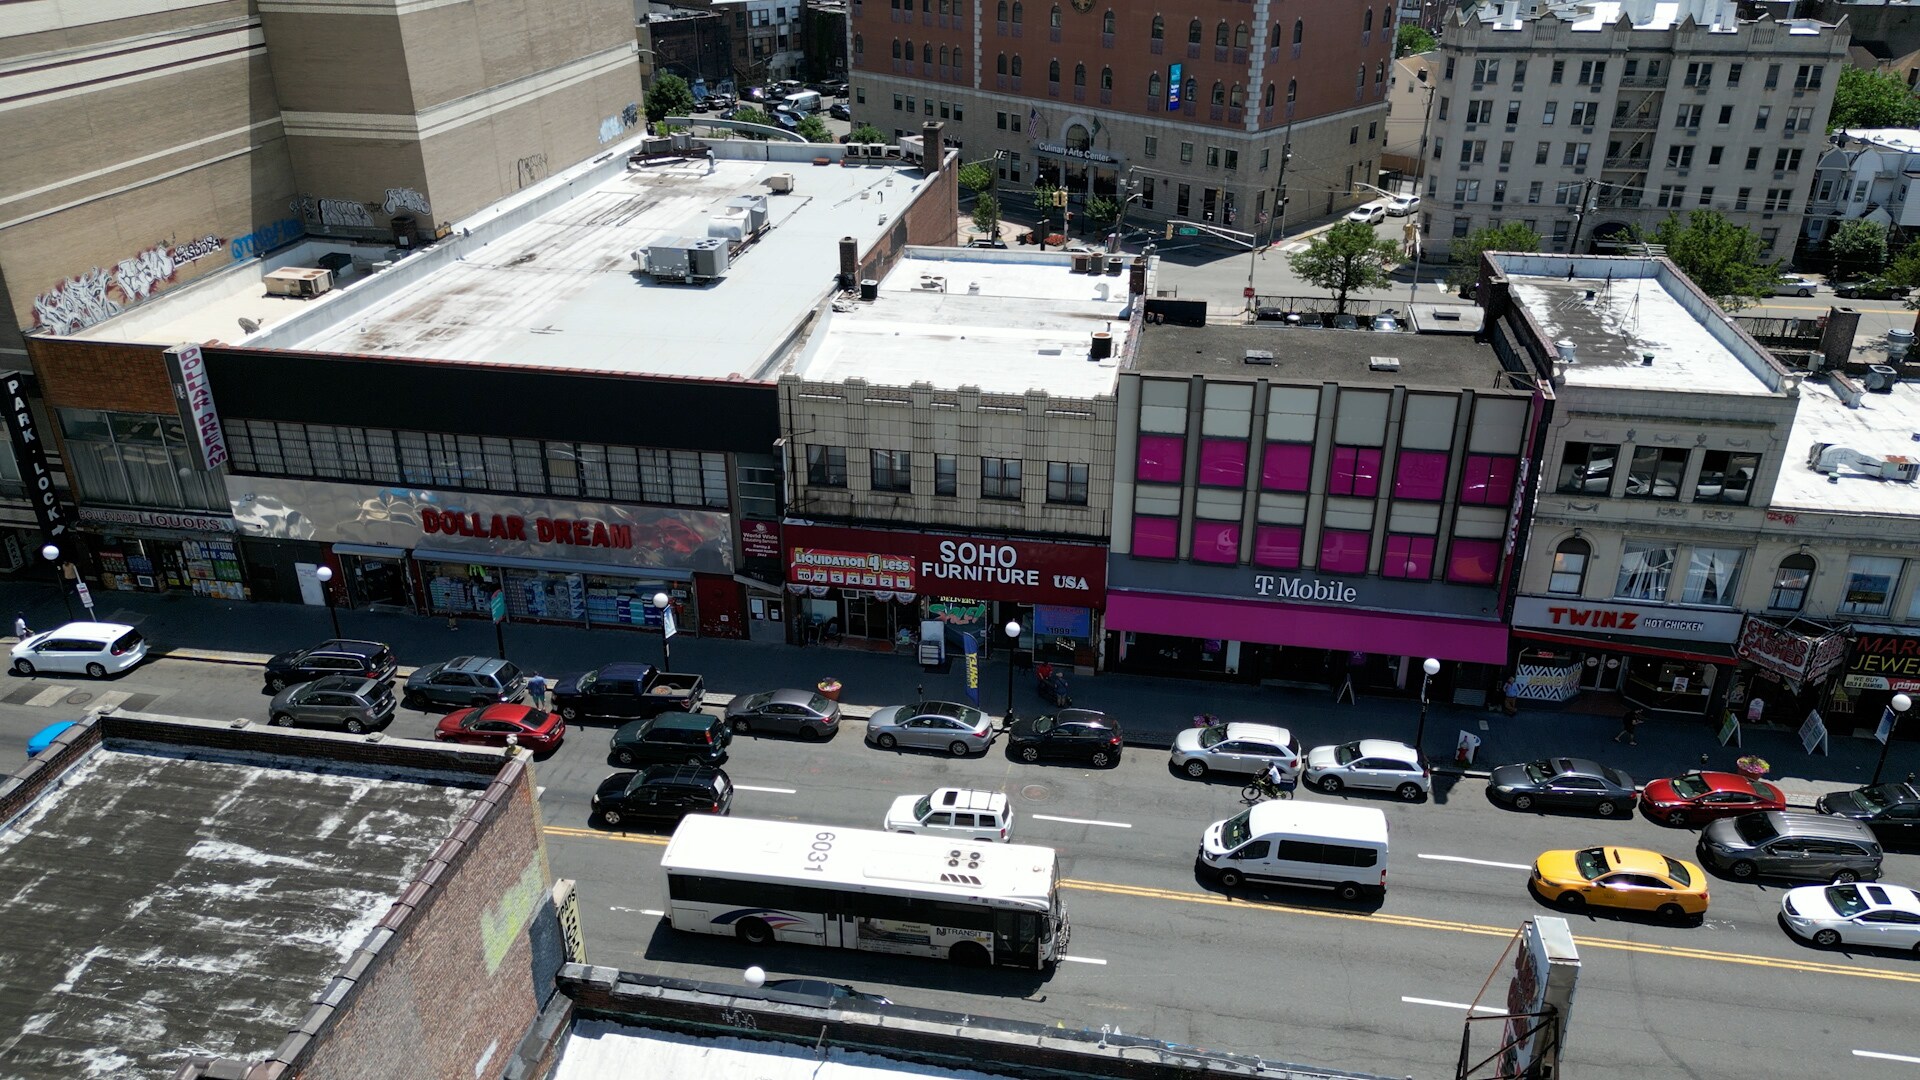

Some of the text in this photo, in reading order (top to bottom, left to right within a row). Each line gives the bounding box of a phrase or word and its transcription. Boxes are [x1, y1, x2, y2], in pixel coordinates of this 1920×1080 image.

[1039, 142, 1109, 162] Culinary Arts Center
[180, 348, 228, 468] DOLLAR DREAM
[8, 380, 61, 522] PARK LOCK
[79, 510, 221, 532] BOULEVARD LIQUORS
[421, 508, 632, 549] DOLLAR DREAM
[208, 542, 234, 551] LOTTERY
[220, 553, 238, 561] SODA
[939, 540, 1017, 568] SOHO
[867, 554, 881, 572] 4
[921, 562, 1090, 591] FURNITURE USA
[1254, 575, 1357, 602] T Mobile
[940, 596, 976, 604] DELIVERY
[1645, 617, 1662, 630] HOT
[1664, 620, 1704, 632] CHICKEN
[1748, 619, 1809, 656] CHECKS
[1857, 635, 1920, 656] MAR
[1743, 632, 1806, 668] CASHED
[1850, 654, 1920, 674] JEWE
[803, 832, 837, 872] 6031
[936, 927, 984, 939] NJ TRANSIT
